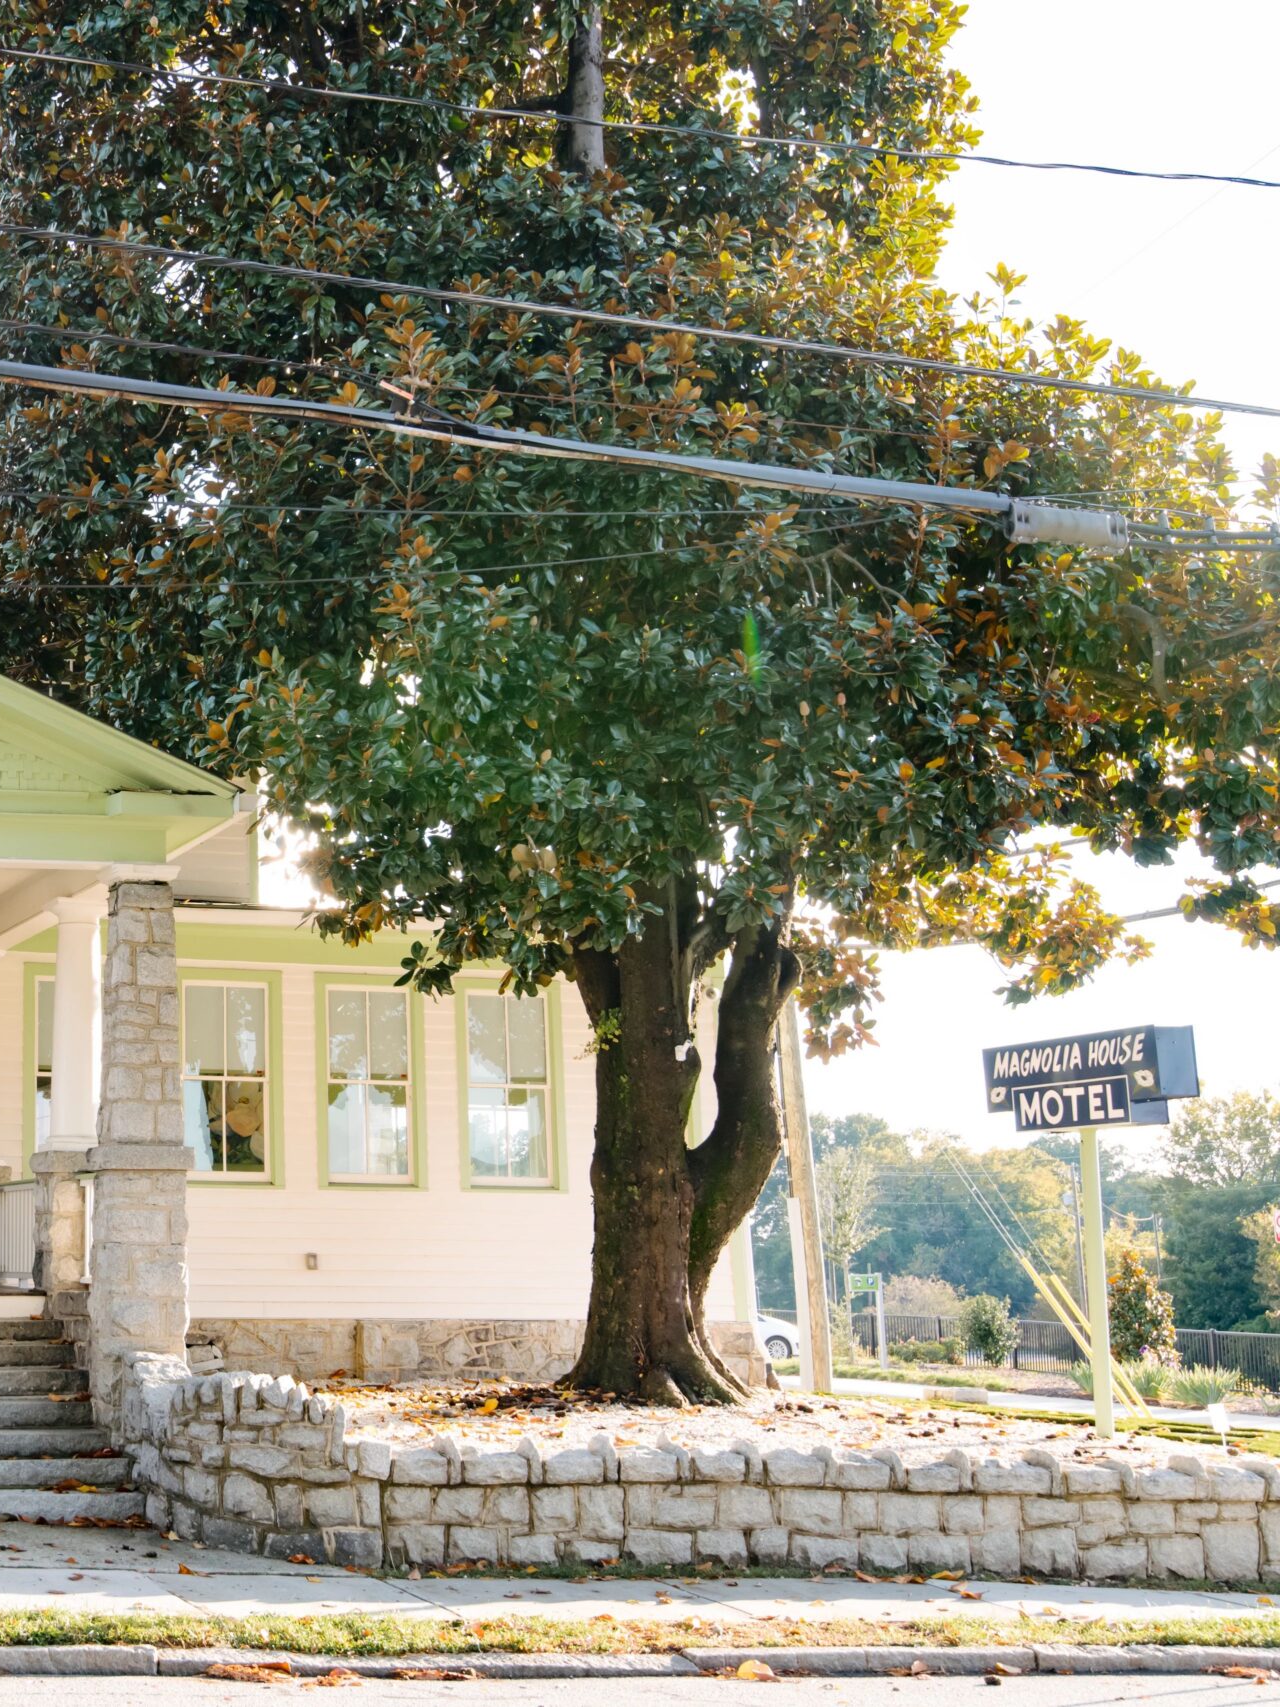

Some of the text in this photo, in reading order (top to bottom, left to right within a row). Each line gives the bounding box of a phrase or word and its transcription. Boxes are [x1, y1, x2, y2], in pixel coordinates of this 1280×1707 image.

[993, 1032, 1146, 1079] MAGNOLIA HOUSE
[1019, 1083, 1125, 1127] MOTEL
